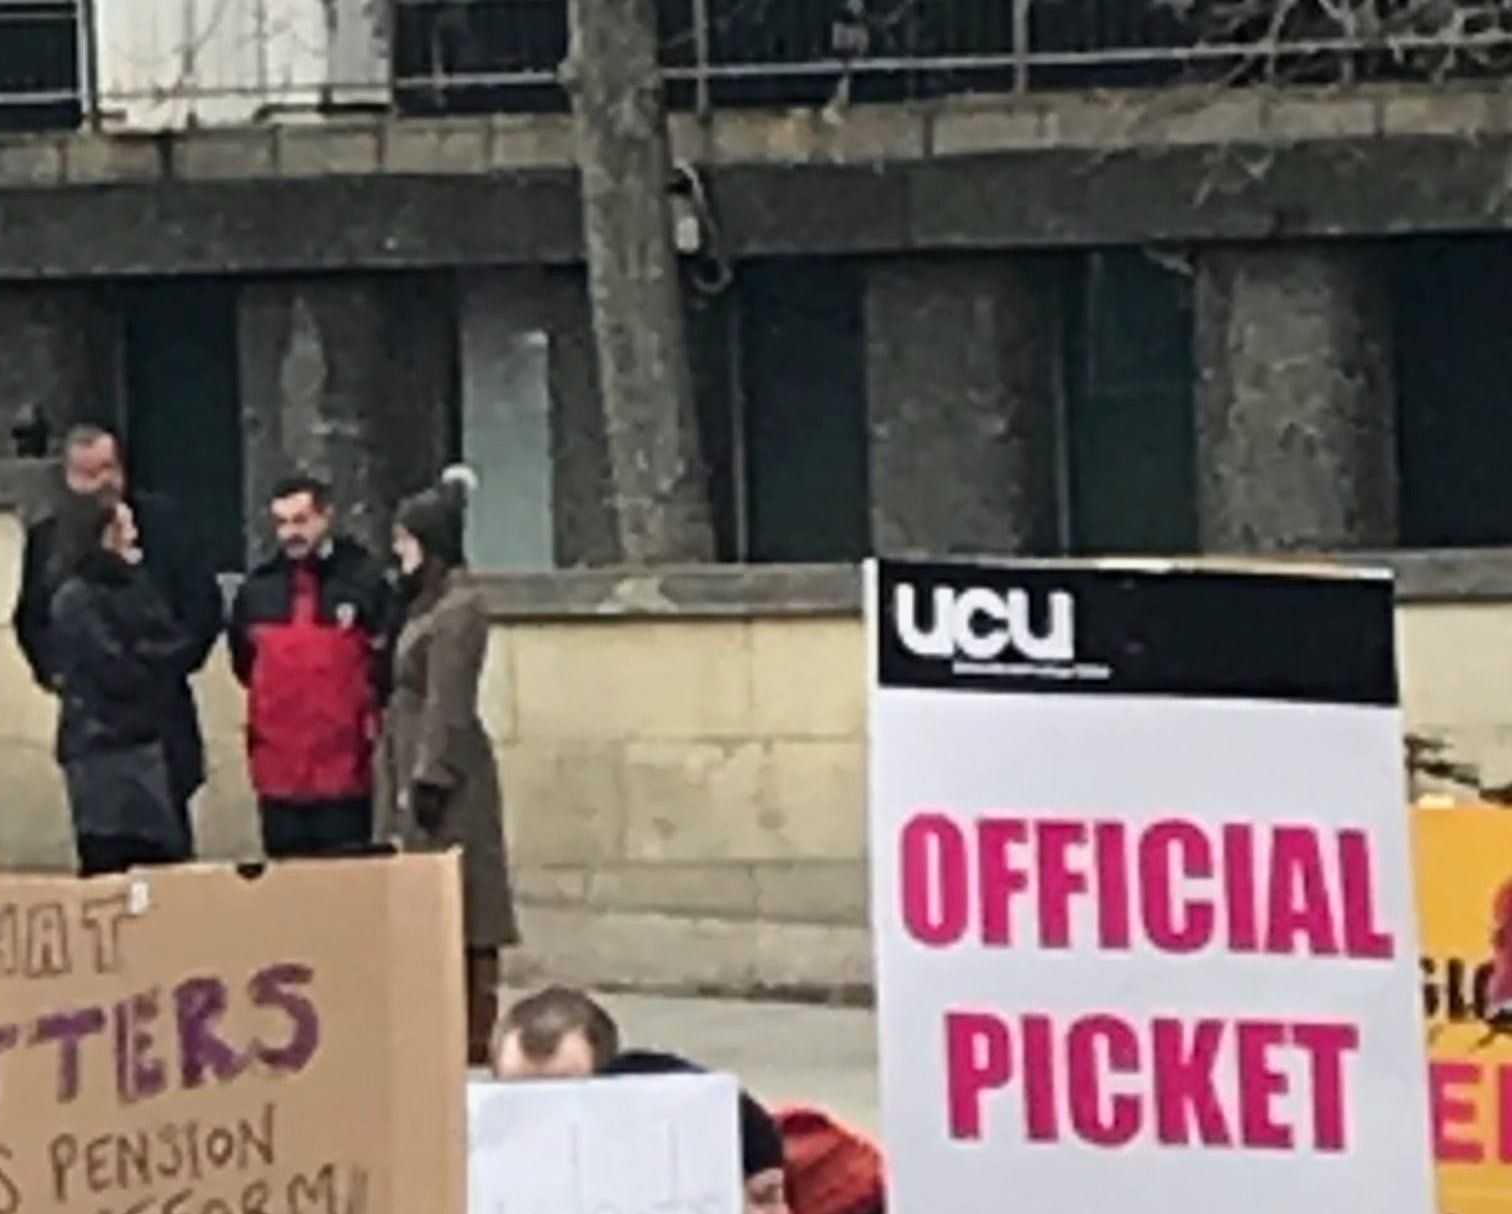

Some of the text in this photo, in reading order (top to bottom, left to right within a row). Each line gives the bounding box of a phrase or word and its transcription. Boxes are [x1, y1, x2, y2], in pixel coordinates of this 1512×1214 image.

[900, 812, 1395, 960] OFFICIAL
[944, 1010, 1360, 1153] PICKET
[49, 1102, 278, 1205] PENSION
